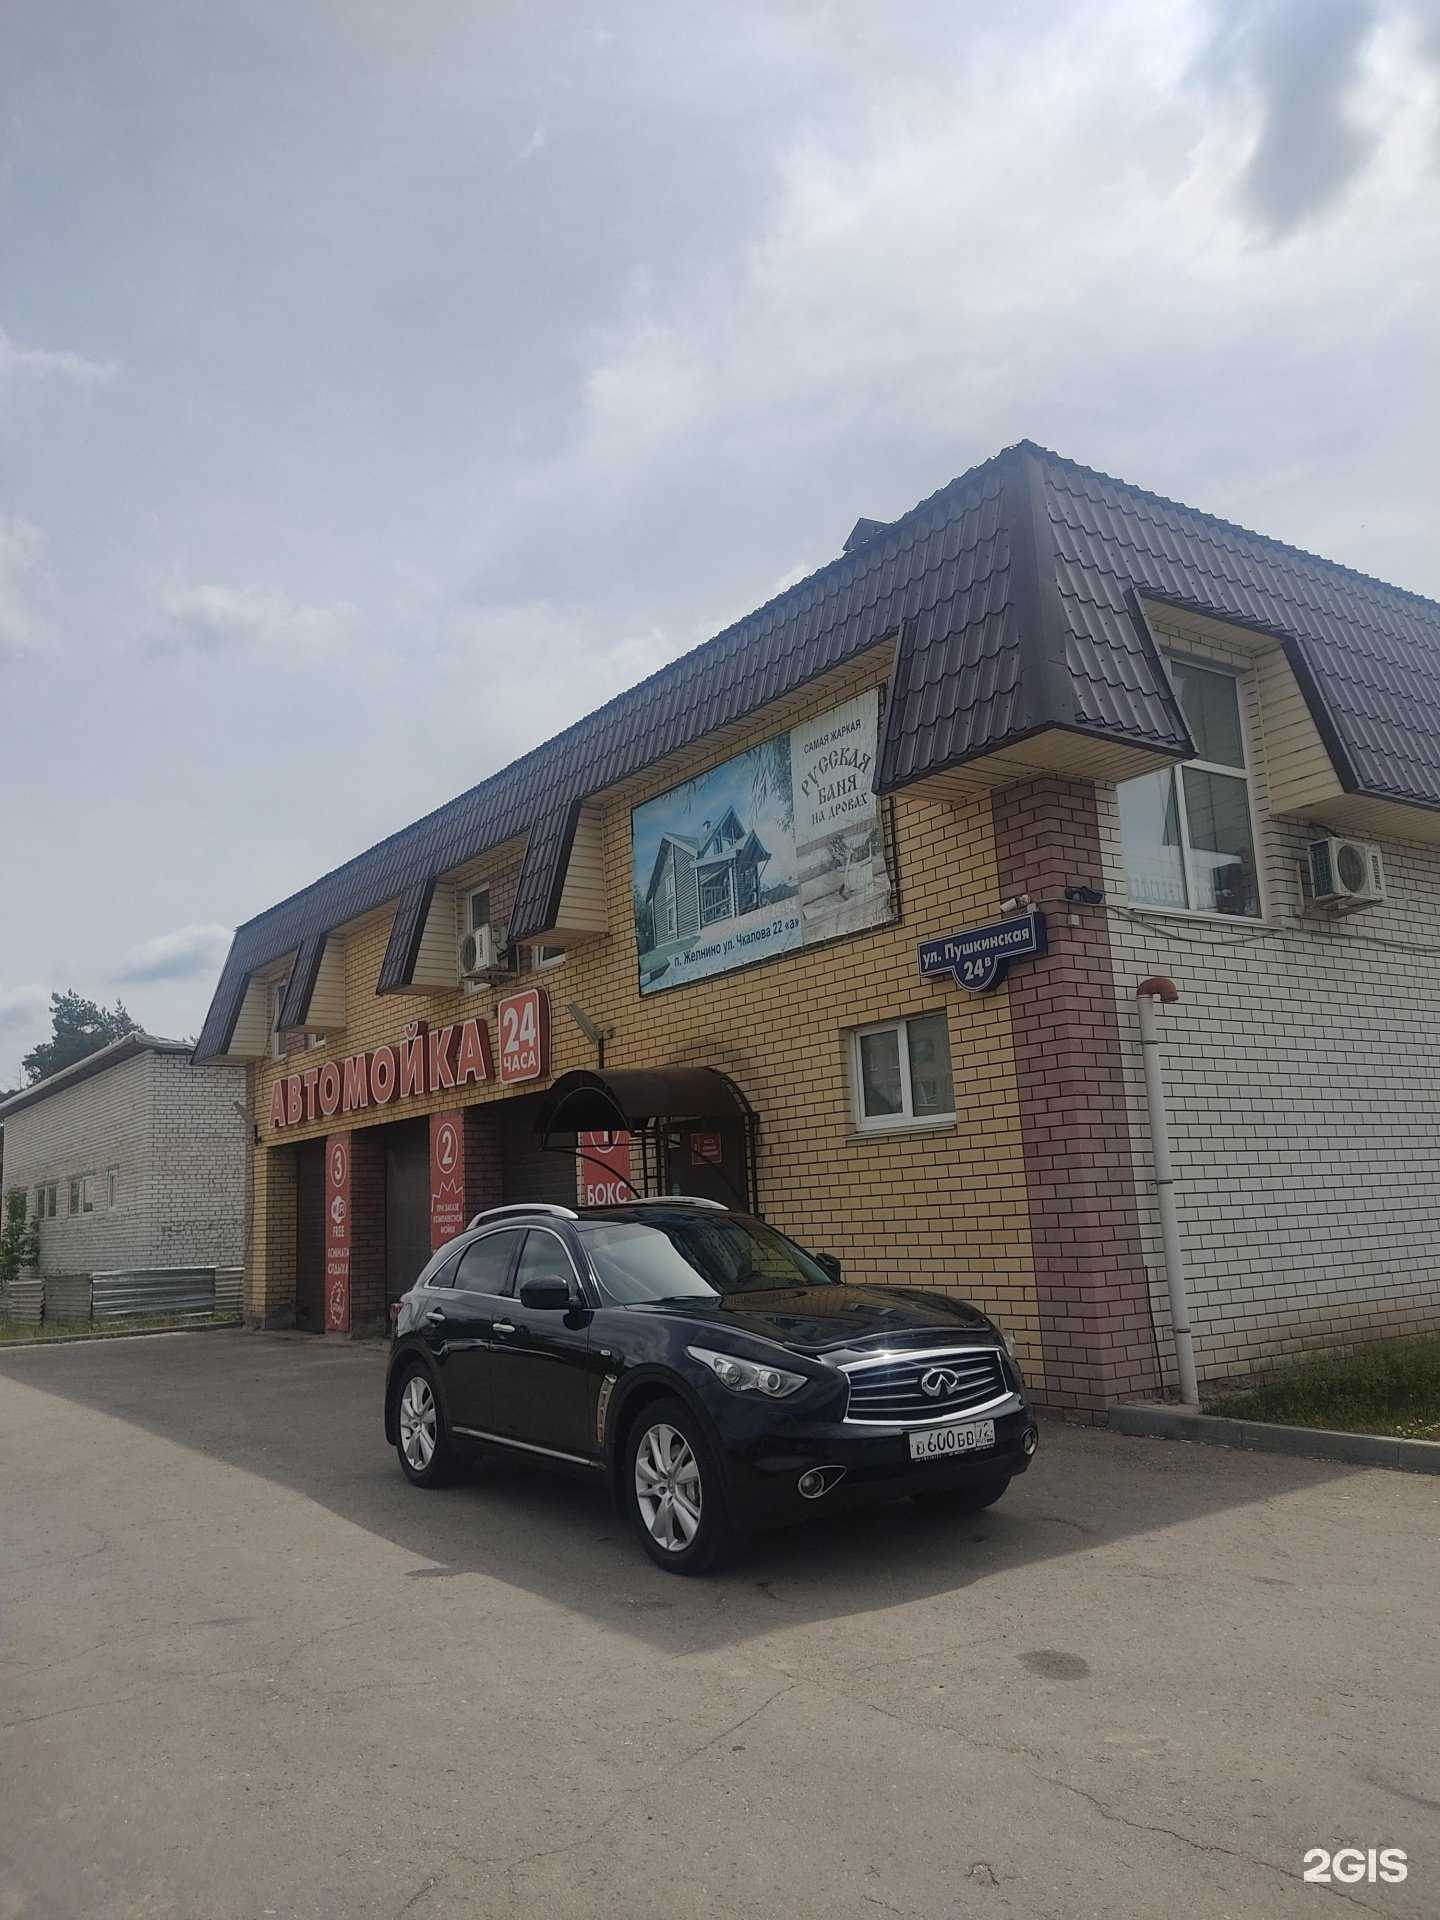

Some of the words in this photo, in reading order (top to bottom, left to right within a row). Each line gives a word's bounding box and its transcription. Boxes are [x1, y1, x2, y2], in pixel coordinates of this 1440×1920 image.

[803, 734, 829, 754] САМАЯ
[830, 719, 861, 741] ЖАРКАЯ
[801, 747, 871, 798] РУССКАЯ
[817, 773, 858, 805] БАНЯ
[811, 812, 826, 825] НА
[828, 792, 868, 820] ДРОВАХ
[673, 957, 682, 967] п.
[683, 943, 721, 964] Желнино
[723, 941, 735, 955] ул.
[736, 926, 771, 947] Чкалова
[772, 919, 783, 935] 22
[922, 951, 942, 969] ул.
[944, 927, 1030, 962] Пушкинская
[502, 1001, 537, 1055] 24
[269, 1018, 488, 1129] АВТОМОЙКА
[503, 1051, 537, 1073] ЧАСА
[441, 1130, 452, 1165] 2
[334, 1151, 342, 1180] 3
[587, 1181, 628, 1205] БОКС
[333, 1225, 345, 1238] FREE
